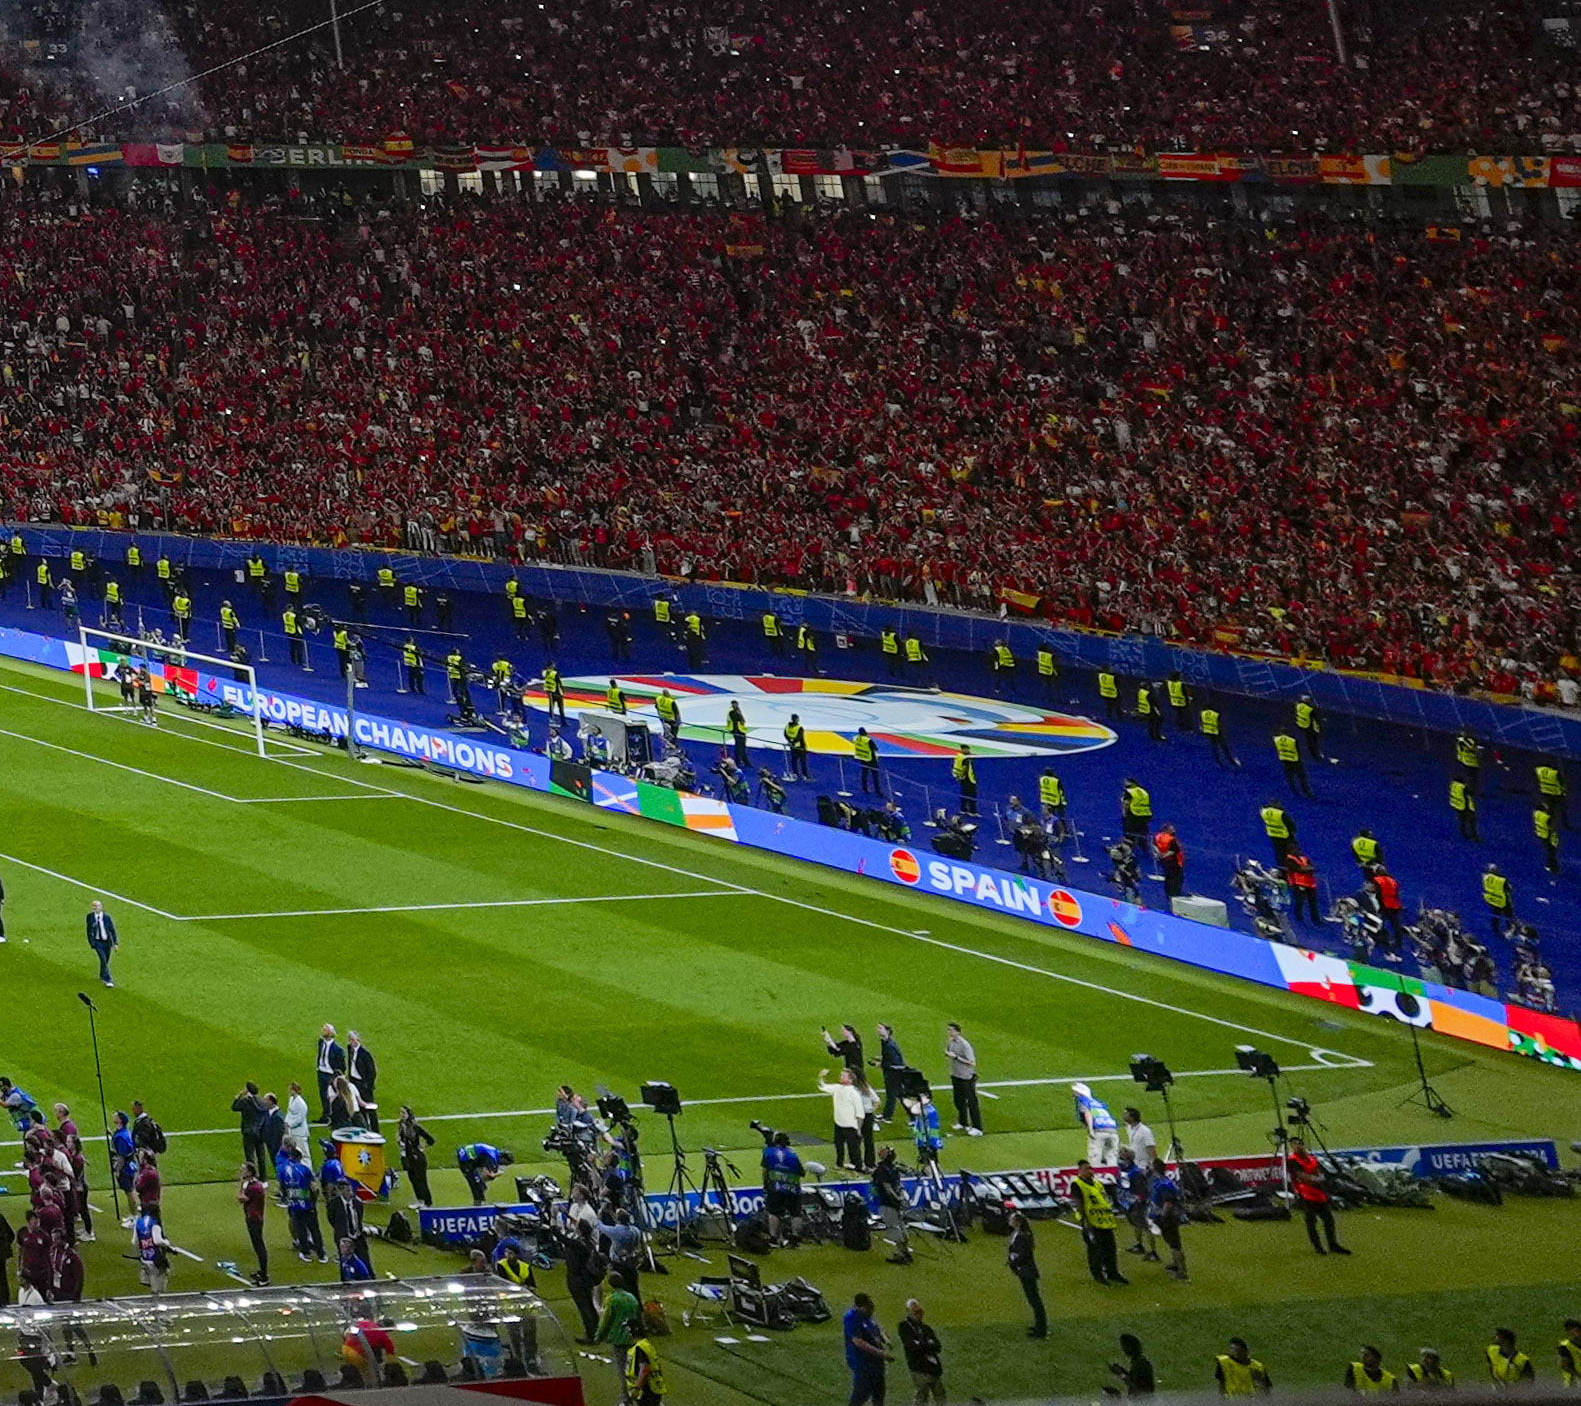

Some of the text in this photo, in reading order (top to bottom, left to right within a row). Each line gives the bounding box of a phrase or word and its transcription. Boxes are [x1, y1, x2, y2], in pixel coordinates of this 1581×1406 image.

[49, 44, 68, 53] 33
[223, 685, 513, 777] EUROPEAN CHAMPIONS
[928, 861, 1042, 916] SPAIN
